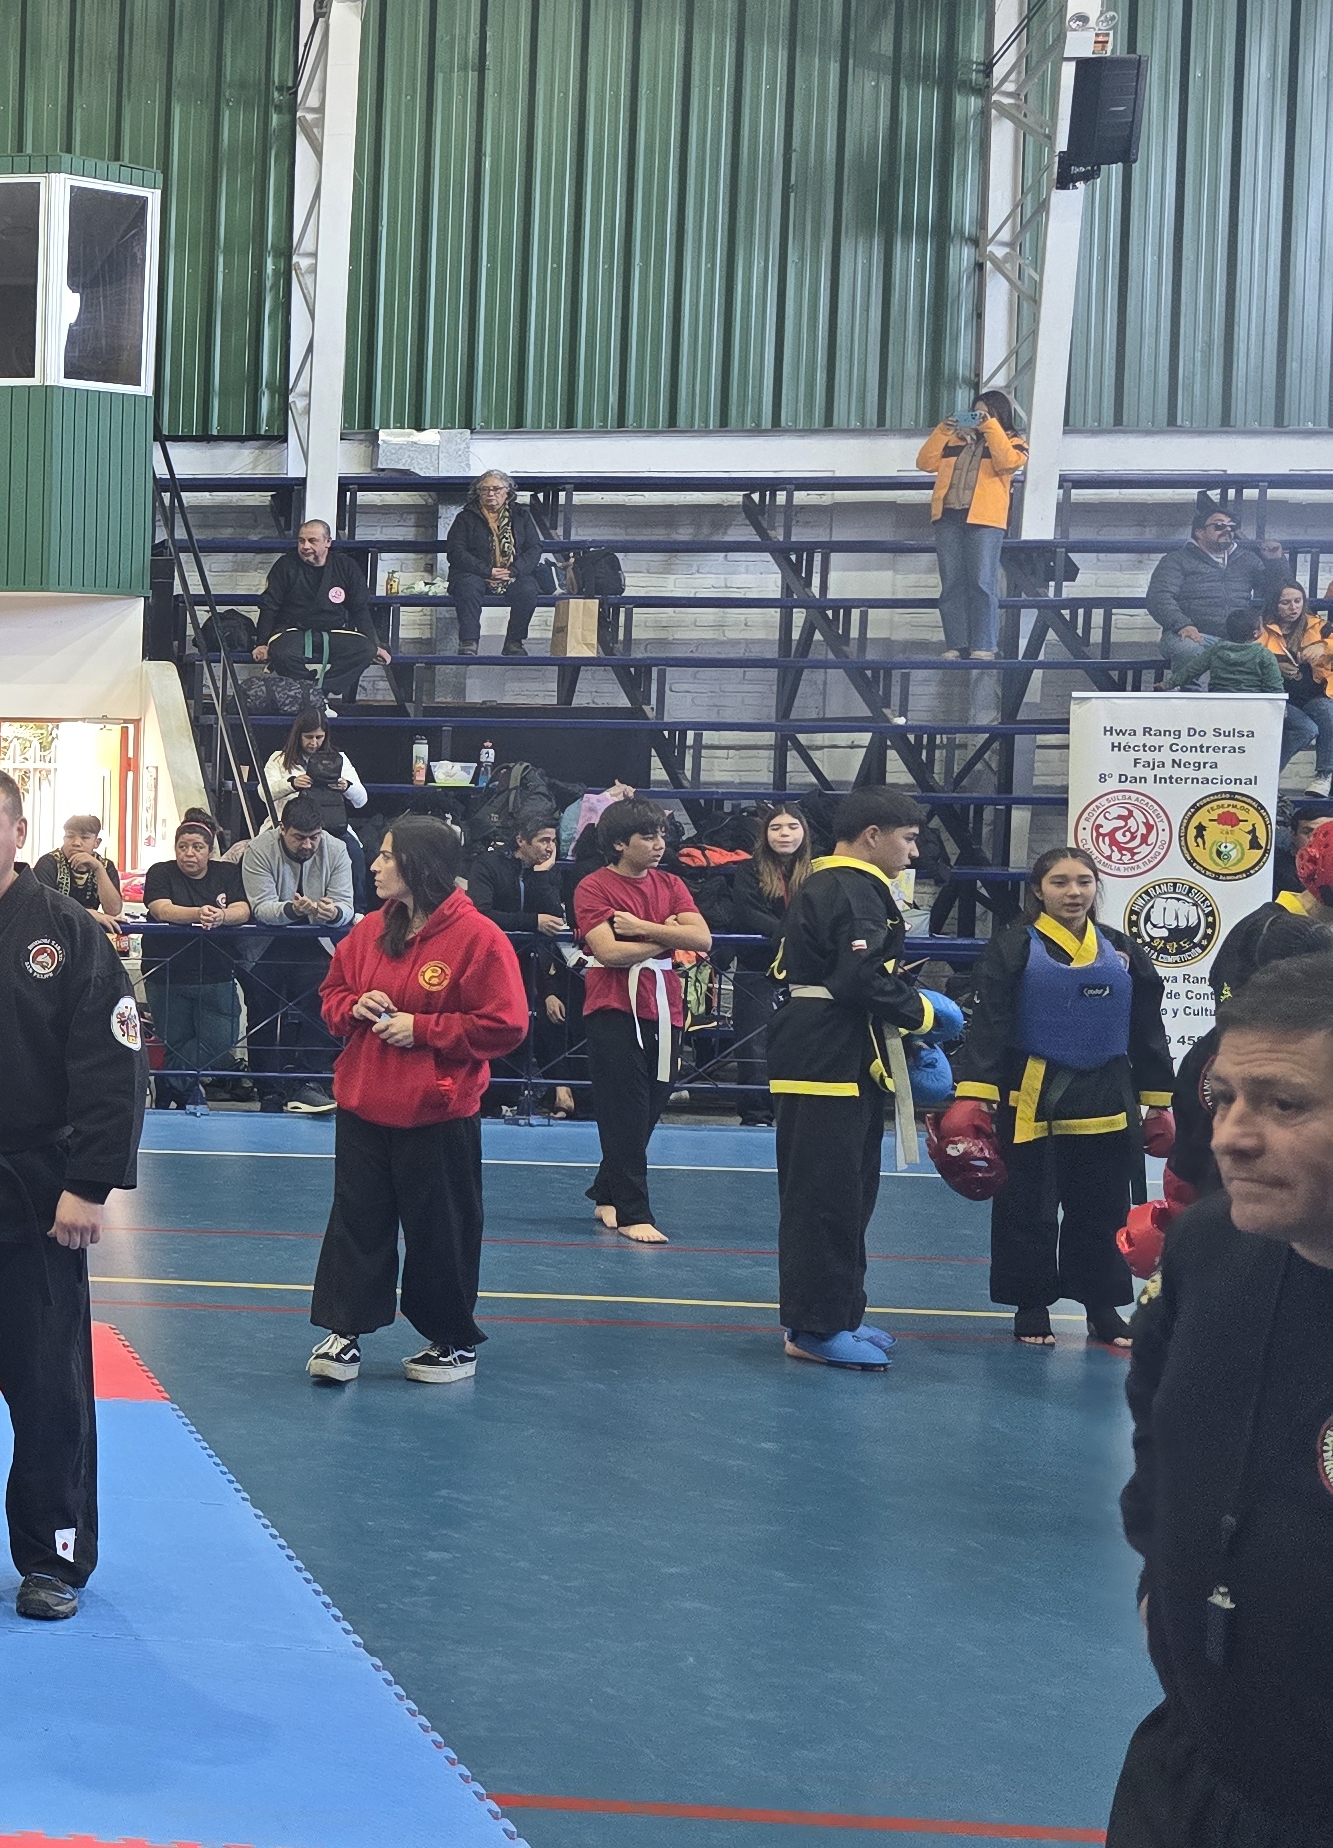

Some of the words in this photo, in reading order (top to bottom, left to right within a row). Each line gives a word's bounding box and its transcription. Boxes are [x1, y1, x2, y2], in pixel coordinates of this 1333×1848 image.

[1103, 726, 1137, 737] Hwa
[1142, 727, 1182, 740] Rang
[1187, 727, 1207, 738] Do
[1212, 728, 1255, 739] Sulsa
[1110, 741, 1164, 753] Héctor
[1169, 743, 1246, 754] Contreras
[1133, 758, 1166, 771] Faja
[1171, 758, 1219, 772] Negra
[1118, 773, 1148, 785] Dan
[1153, 775, 1258, 786] Internacional
[1084, 801, 1106, 823] ROYAL
[1106, 794, 1133, 804] SULSA
[1133, 796, 1165, 824] ACADEMY
[1094, 854, 1121, 872] FAMILIA
[1141, 851, 1162, 867] RANG
[1158, 839, 1167, 851] DO
[1131, 893, 1151, 913] HWA
[1148, 882, 1174, 898] RANG
[1175, 882, 1190, 895] DO
[1188, 888, 1213, 914] SULSA
[1166, 990, 1181, 1000] de
[1172, 1008, 1179, 1018] y
